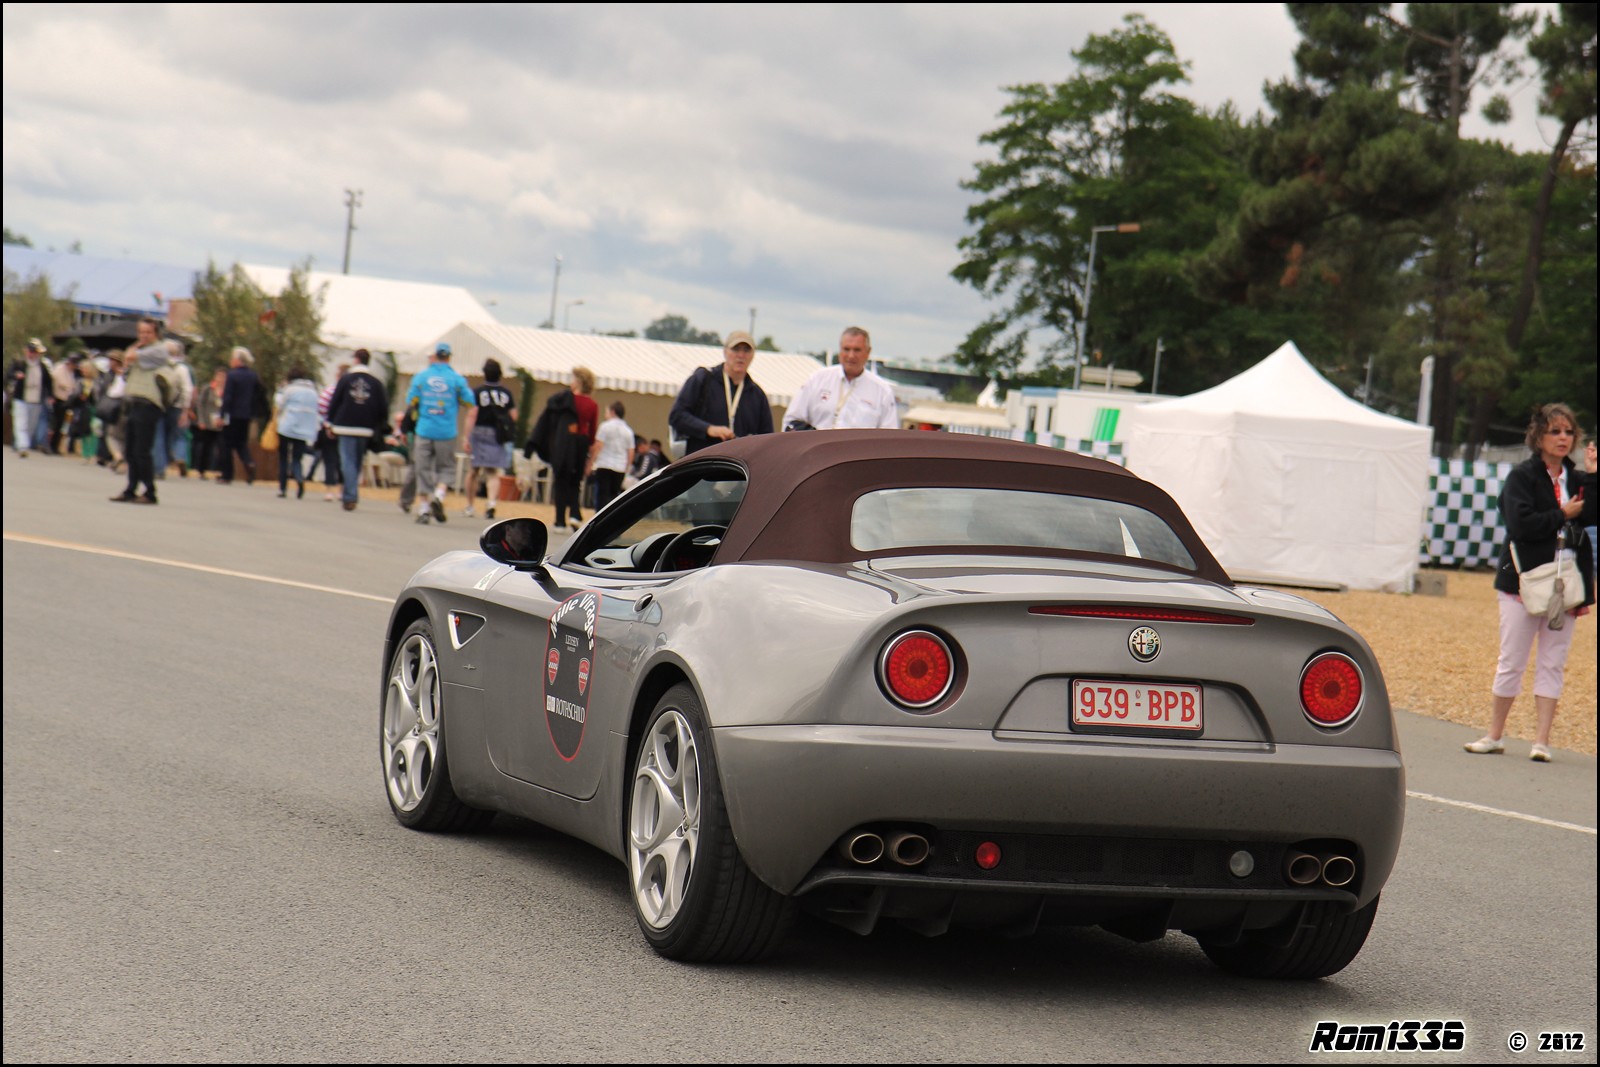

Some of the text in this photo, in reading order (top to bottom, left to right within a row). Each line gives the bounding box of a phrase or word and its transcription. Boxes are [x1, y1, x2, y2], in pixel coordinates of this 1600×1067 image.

[551, 594, 596, 651] Mille Virages
[555, 698, 586, 724] ROTHSCHILD
